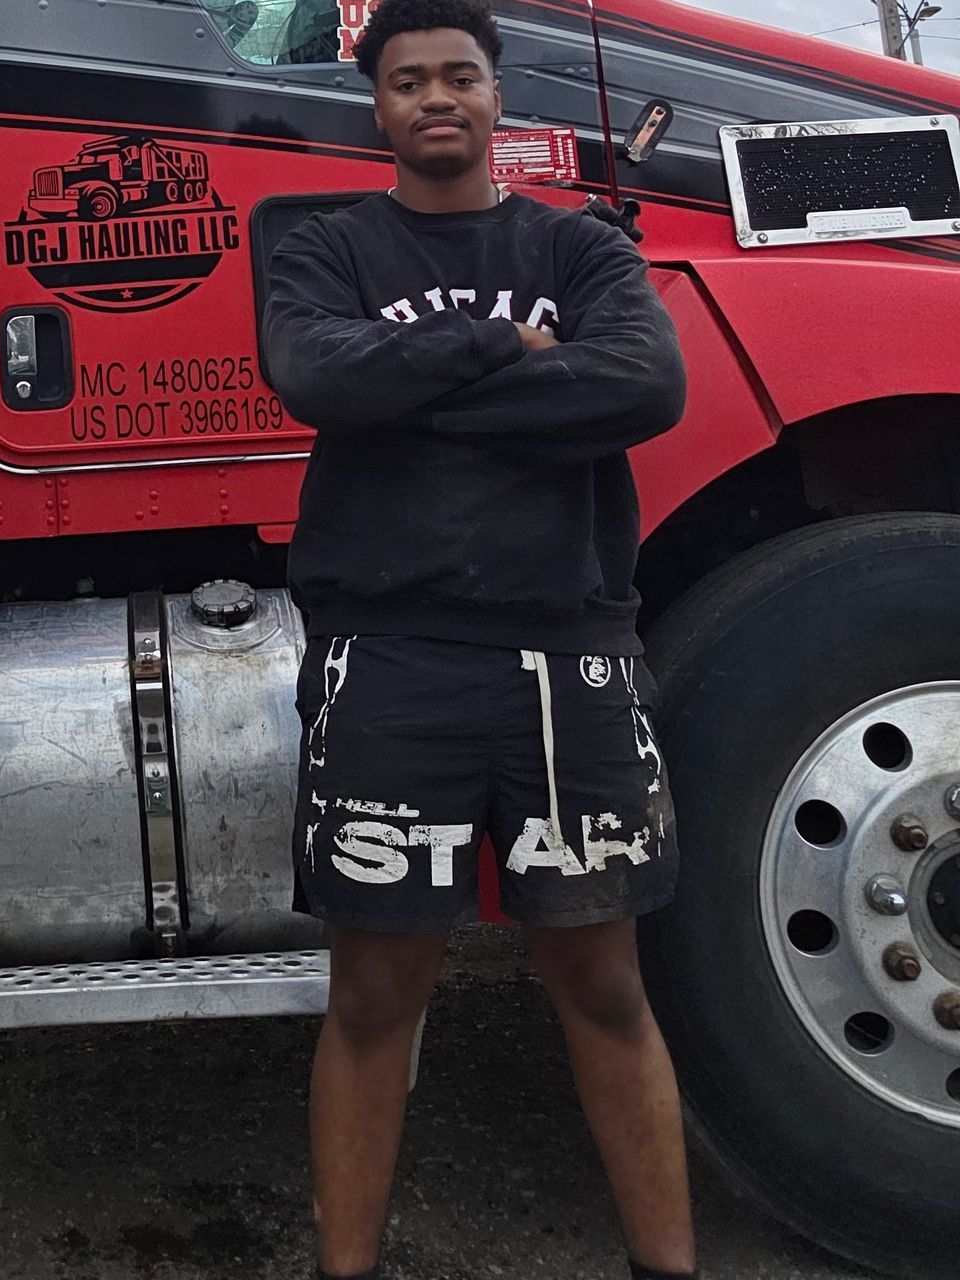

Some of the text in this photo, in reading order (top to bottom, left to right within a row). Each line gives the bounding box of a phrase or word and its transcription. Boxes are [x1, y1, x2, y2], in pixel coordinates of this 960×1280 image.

[5, 214, 240, 266] DGJ HAULING LLC
[80, 356, 254, 398] MC 1480625
[70, 395, 284, 441] US DOT 3966169
